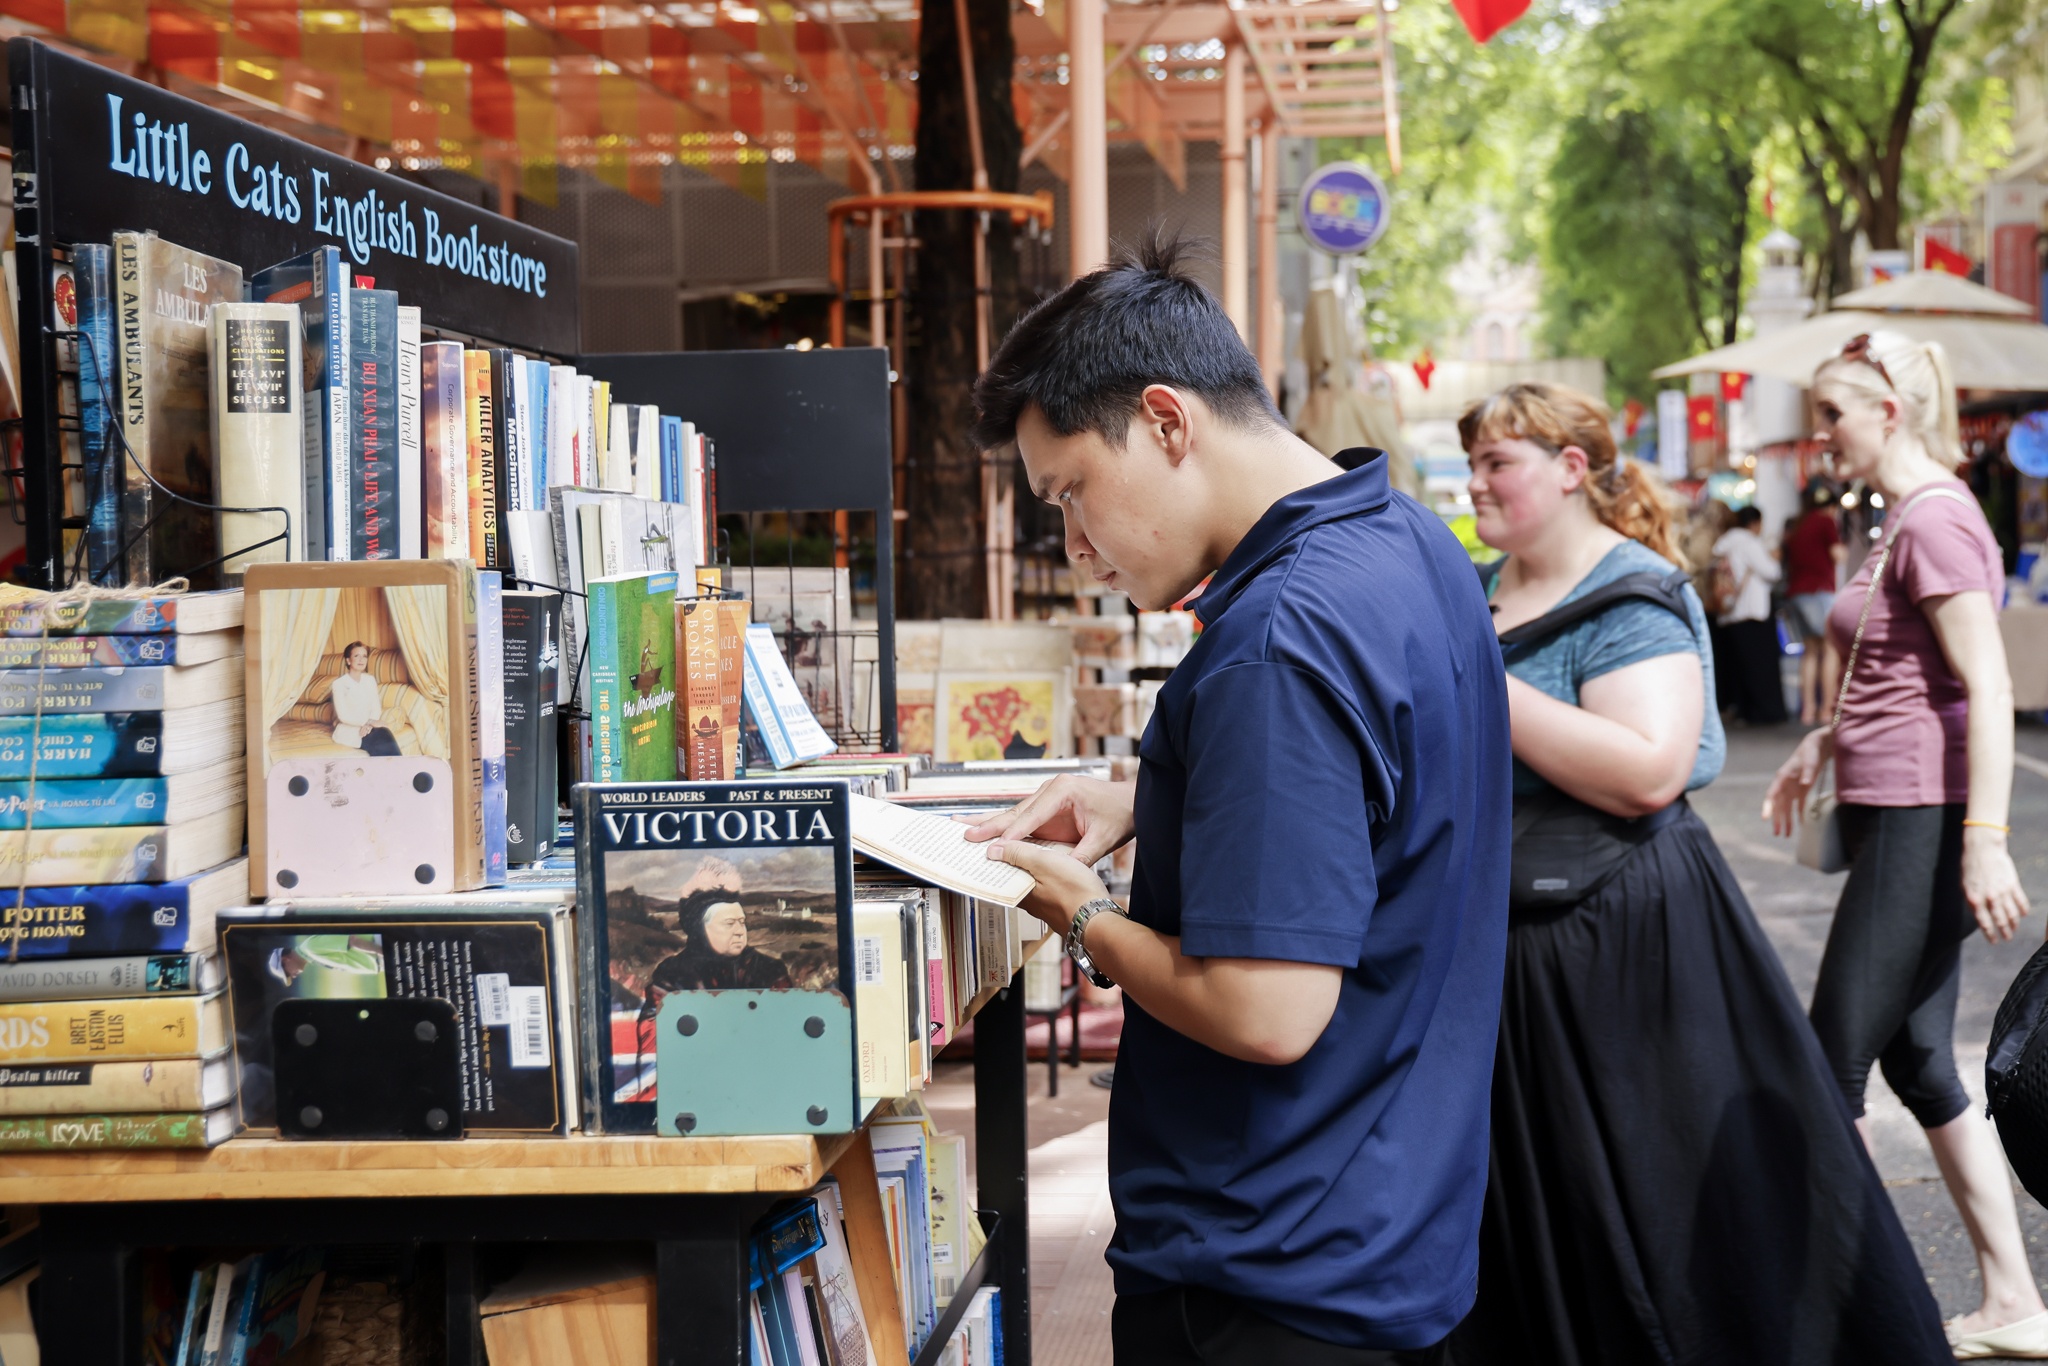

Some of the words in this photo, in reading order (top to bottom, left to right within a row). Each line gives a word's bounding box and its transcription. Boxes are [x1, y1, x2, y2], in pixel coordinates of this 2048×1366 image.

[106, 93, 212, 194] Little
[226, 142, 301, 224] Cats
[314, 168, 417, 265] English
[424, 208, 547, 298] Bookstore
[121, 239, 138, 281] LES
[183, 261, 208, 290] LES
[331, 292, 339, 343] EXPLORING
[123, 291, 145, 426] AMBULANTS
[232, 370, 254, 378] LES
[332, 345, 341, 381] HISTORY
[399, 340, 417, 391] Henry
[332, 392, 342, 424] JAPAN
[400, 393, 417, 449] Purcell
[446, 384, 455, 423] Corporate
[479, 395, 492, 443] KILLER
[448, 424, 456, 471] Governance
[522, 462, 527, 474] by
[364, 472, 378, 503] LIFE
[480, 449, 495, 529] ANALYTICS
[365, 507, 378, 536] AND
[450, 489, 458, 545] Accountability
[488, 584, 498, 609] Di
[598, 587, 608, 660] CONJUNCTIONS:27
[487, 616, 500, 703] Morrissey
[688, 620, 702, 680] BONES
[702, 609, 717, 682] ORACLE
[623, 700, 635, 717] the
[489, 754, 501, 783] Bay
[601, 792, 648, 804] WORLD
[651, 791, 706, 803] LEADERS
[729, 790, 760, 802] PAST
[764, 790, 775, 801] &
[779, 789, 833, 801] PRESENT
[603, 808, 835, 844] VICTORIA
[4, 906, 86, 923] POTTER
[0, 973, 36, 988] AVID
[43, 971, 100, 986] DORSEY
[70, 1017, 87, 1045] BRET
[90, 1010, 106, 1052] EASTON
[108, 1013, 125, 1045] ELLIS
[177, 1017, 185, 1038] Swift
[44, 1069, 80, 1082] killer
[862, 1041, 870, 1083] OXFORD
[53, 1122, 104, 1143] LOVE
